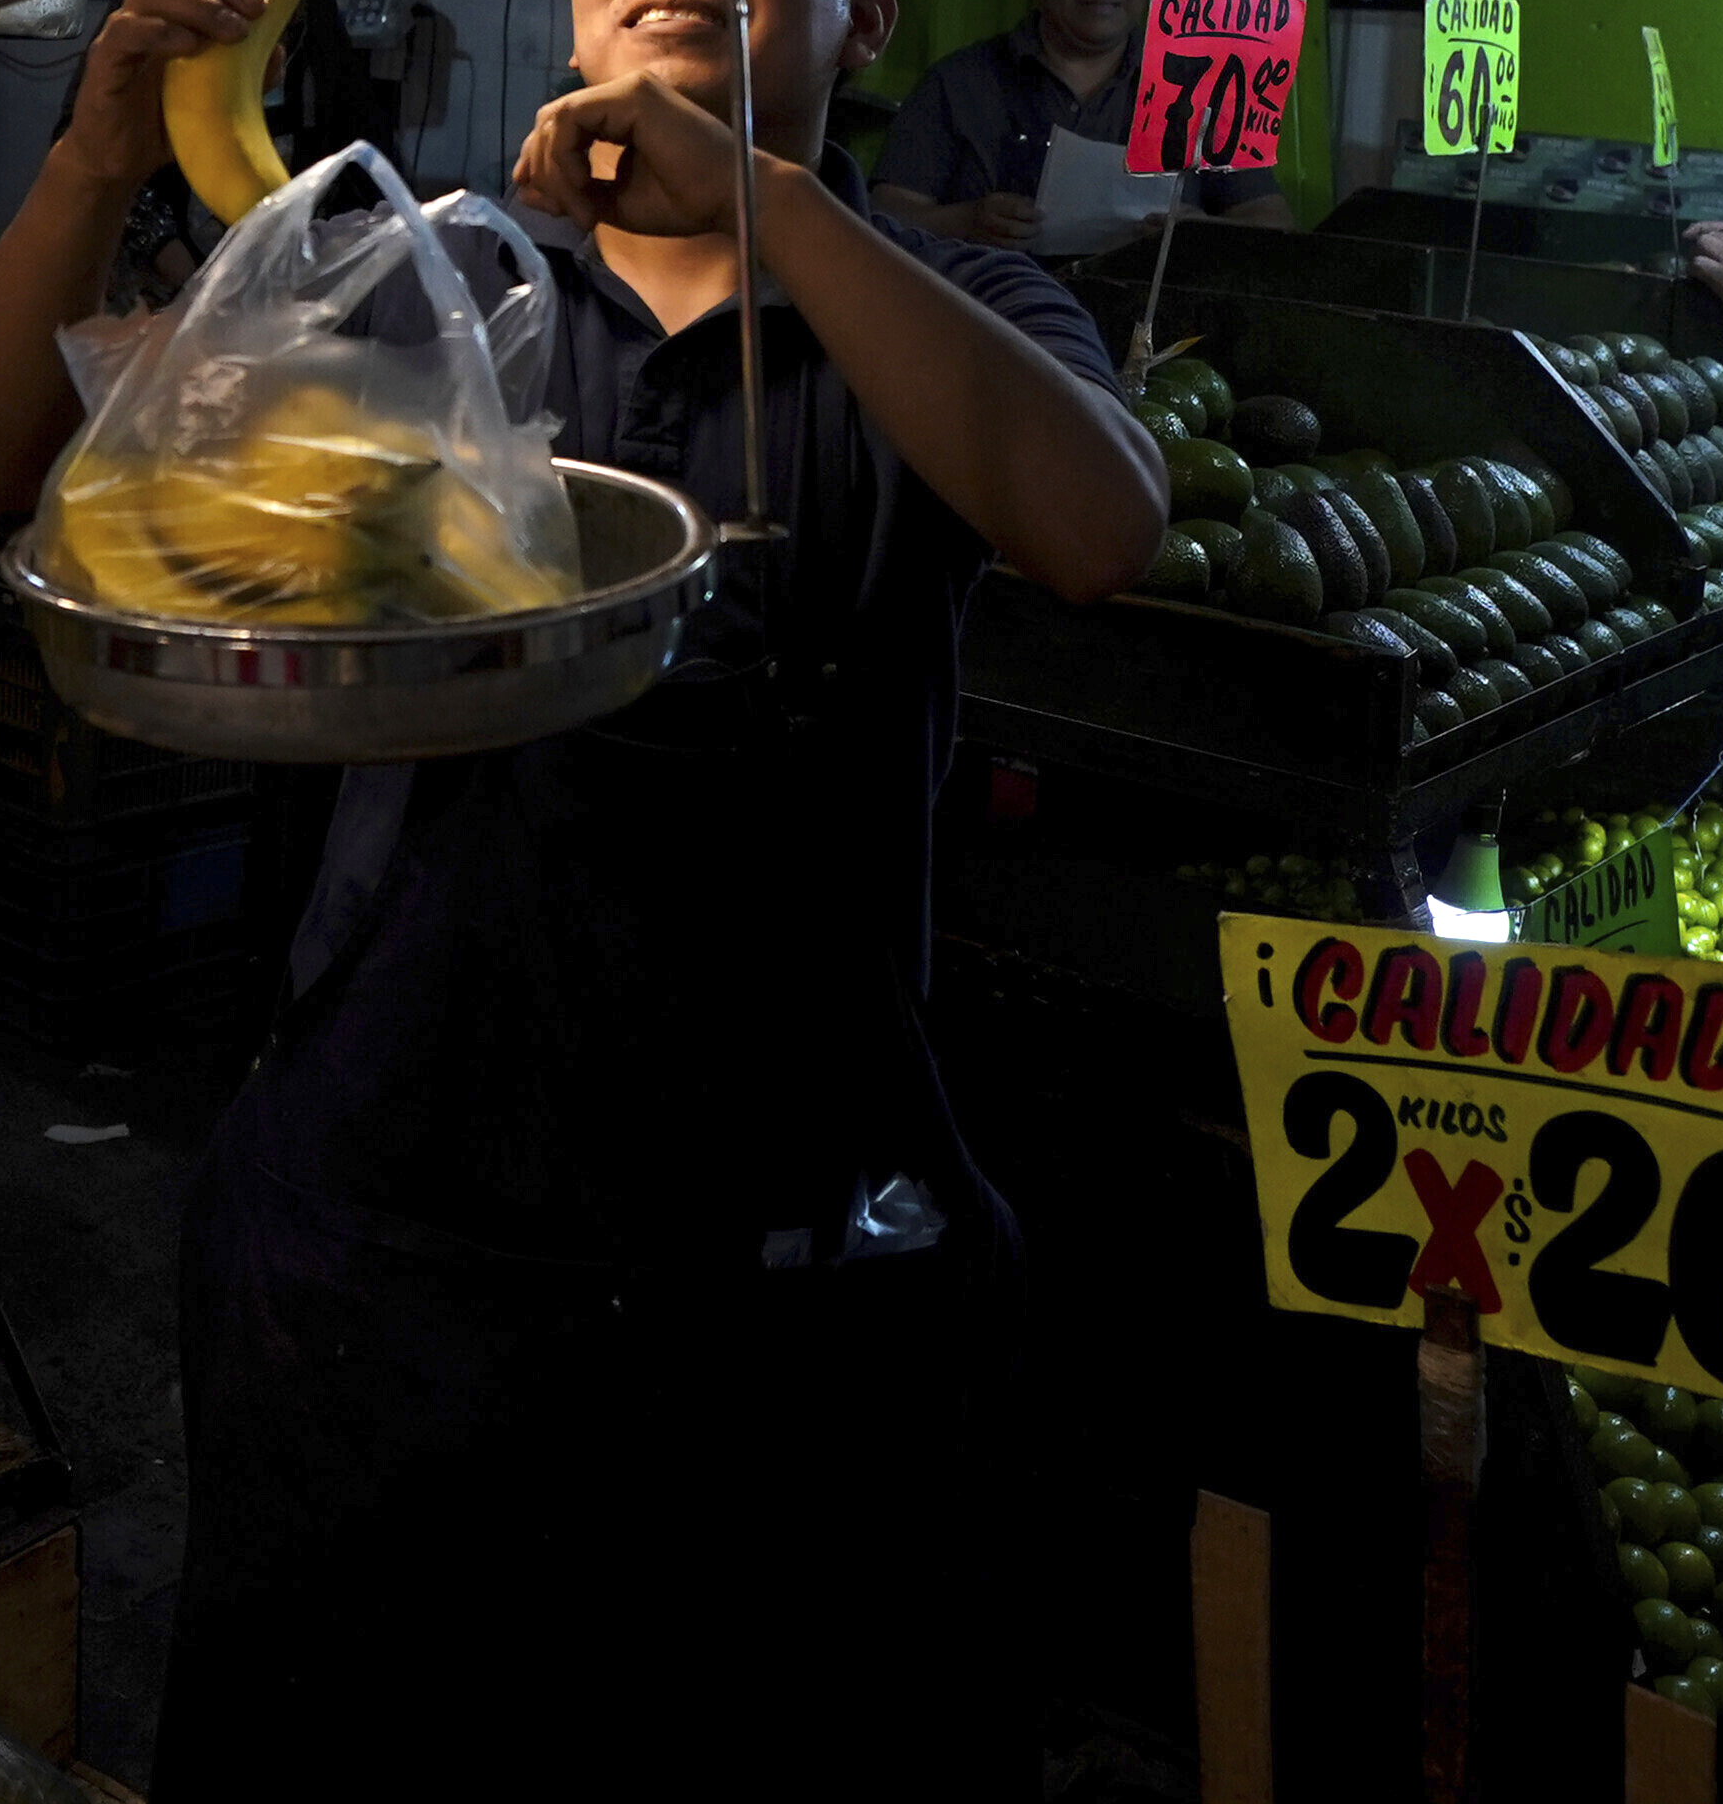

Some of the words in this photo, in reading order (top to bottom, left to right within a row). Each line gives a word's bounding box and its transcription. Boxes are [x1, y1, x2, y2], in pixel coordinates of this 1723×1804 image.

[1161, 50, 1246, 172] 70
[1245, 105, 1281, 136] KILO
[1438, 46, 1491, 147] 60
[1496, 51, 1515, 86] 00
[1543, 843, 1656, 944] CALIDAD
[1283, 1071, 1419, 1309] 2
[1399, 1094, 1508, 1143] KILOS
